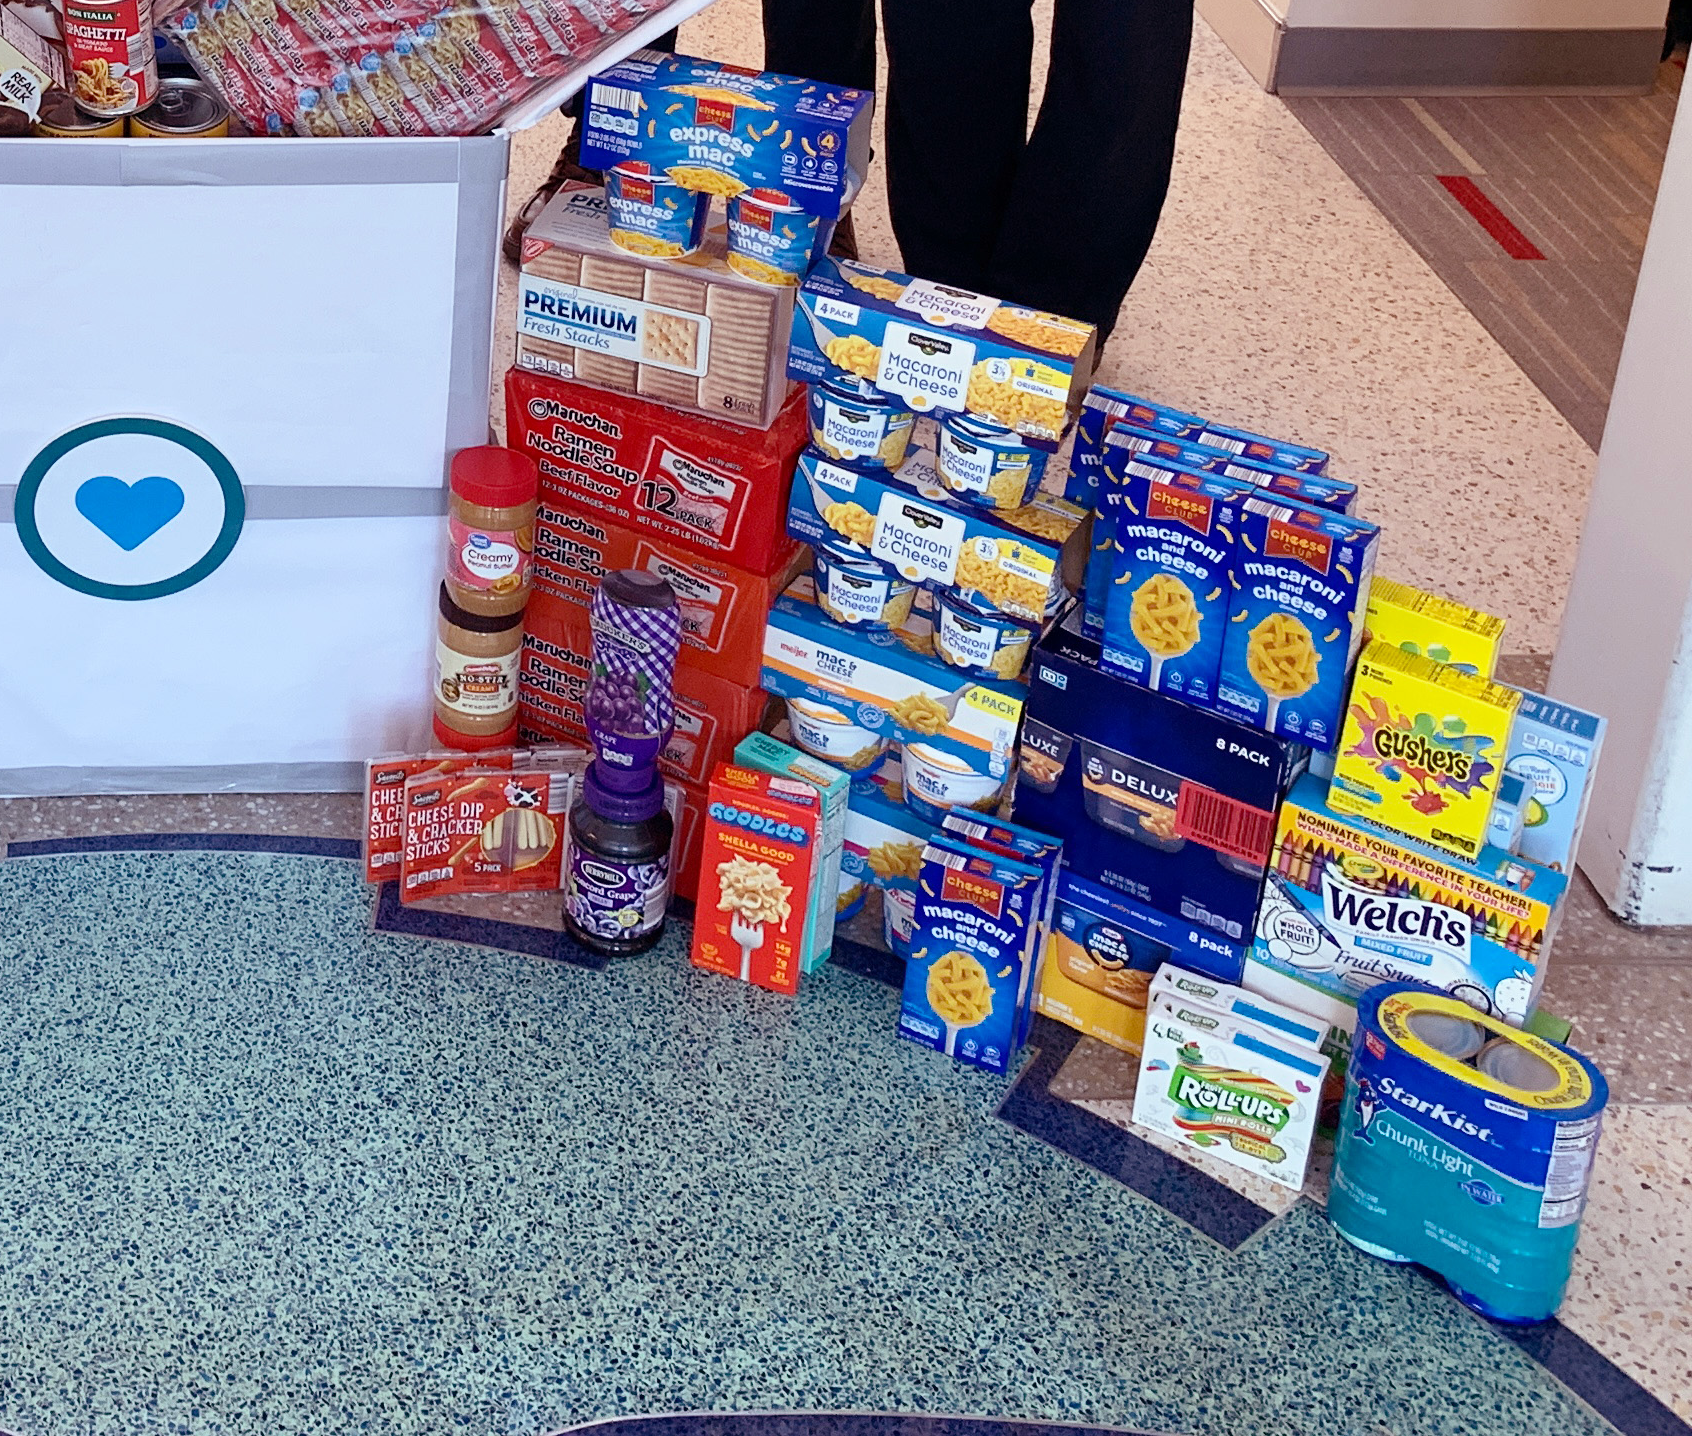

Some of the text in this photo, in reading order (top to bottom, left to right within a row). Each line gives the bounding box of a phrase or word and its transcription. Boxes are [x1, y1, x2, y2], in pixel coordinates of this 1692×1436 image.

[64, 22, 128, 43] SPAGHETTI
[1, 77, 32, 106] MILK
[7, 68, 37, 95] REAL
[669, 126, 755, 158] express
[688, 145, 736, 167] mac
[524, 290, 637, 335] PREMIUM
[819, 302, 854, 320] 4 PACK
[524, 317, 610, 350] Fresh Stacks
[883, 367, 959, 399] & Cheese
[889, 351, 963, 385] Macaroni
[545, 400, 620, 438] Maruchan
[527, 430, 638, 486] Noodle Soup
[552, 425, 615, 458] Ramen
[539, 460, 621, 499] Beef Flavor
[642, 481, 678, 518] 12
[468, 550, 514, 565] Creamy
[1127, 523, 1226, 565] macaroni
[1162, 541, 1186, 556] and
[1136, 546, 1209, 580] cheese
[1215, 737, 1271, 767] 8 PACK
[1374, 729, 1469, 781] Gushers
[1111, 768, 1178, 806] DELUX
[408, 819, 483, 844] & CRACKER
[409, 802, 484, 827] CHEESE DIP
[709, 802, 806, 844] GOODLES
[407, 839, 451, 862] STICKS
[1298, 810, 1532, 911] NOMINATE YOUR FAVORITE TEACHER!
[1329, 883, 1466, 947] Welch's
[1179, 1076, 1286, 1126] ROLL-UPS
[1379, 1076, 1493, 1143] StarKist
[1376, 1119, 1474, 1178] Chunk Light
